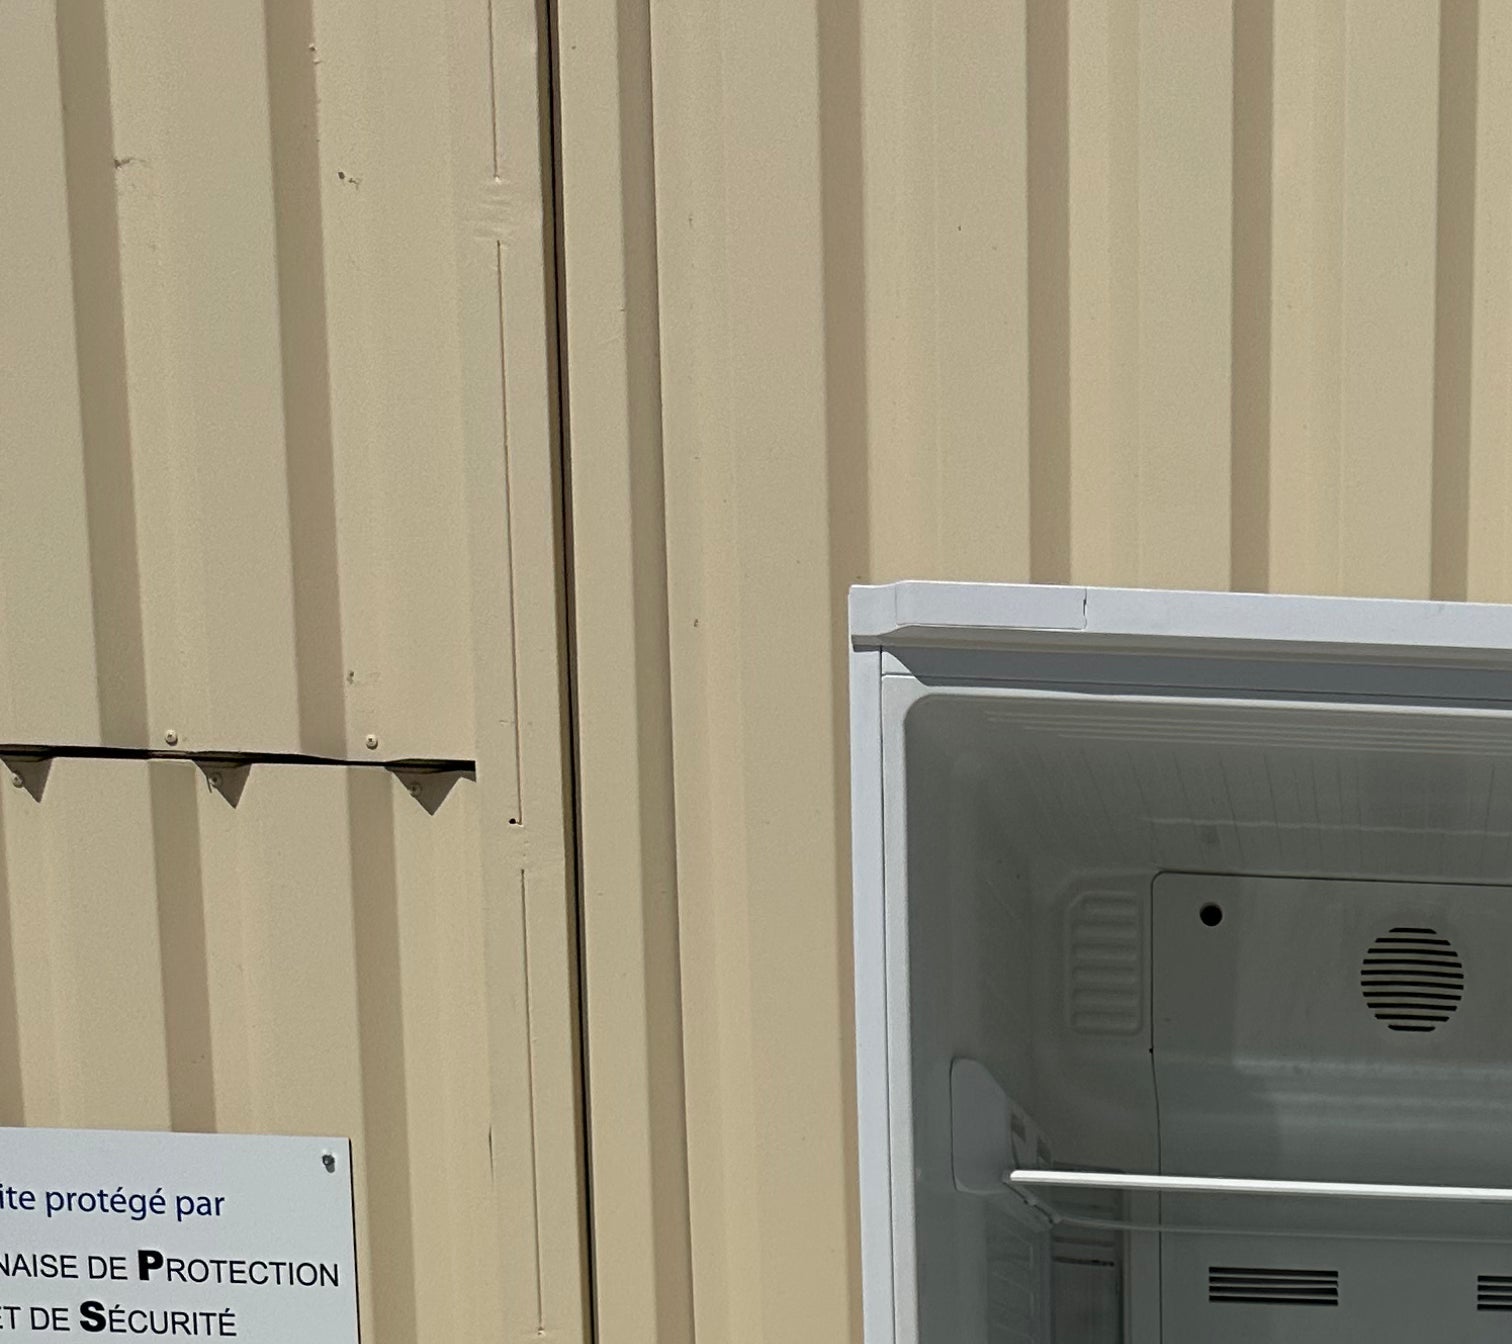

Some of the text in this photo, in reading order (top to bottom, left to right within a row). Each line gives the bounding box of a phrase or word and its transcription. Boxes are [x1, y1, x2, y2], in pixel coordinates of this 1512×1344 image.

[46, 1187, 167, 1221] protégé
[176, 1194, 225, 1222] par
[88, 1255, 128, 1280] DE
[138, 1249, 339, 1287] PROTECTION
[30, 1306, 70, 1331] DE
[79, 1300, 237, 1336] SÉCURITÉ
